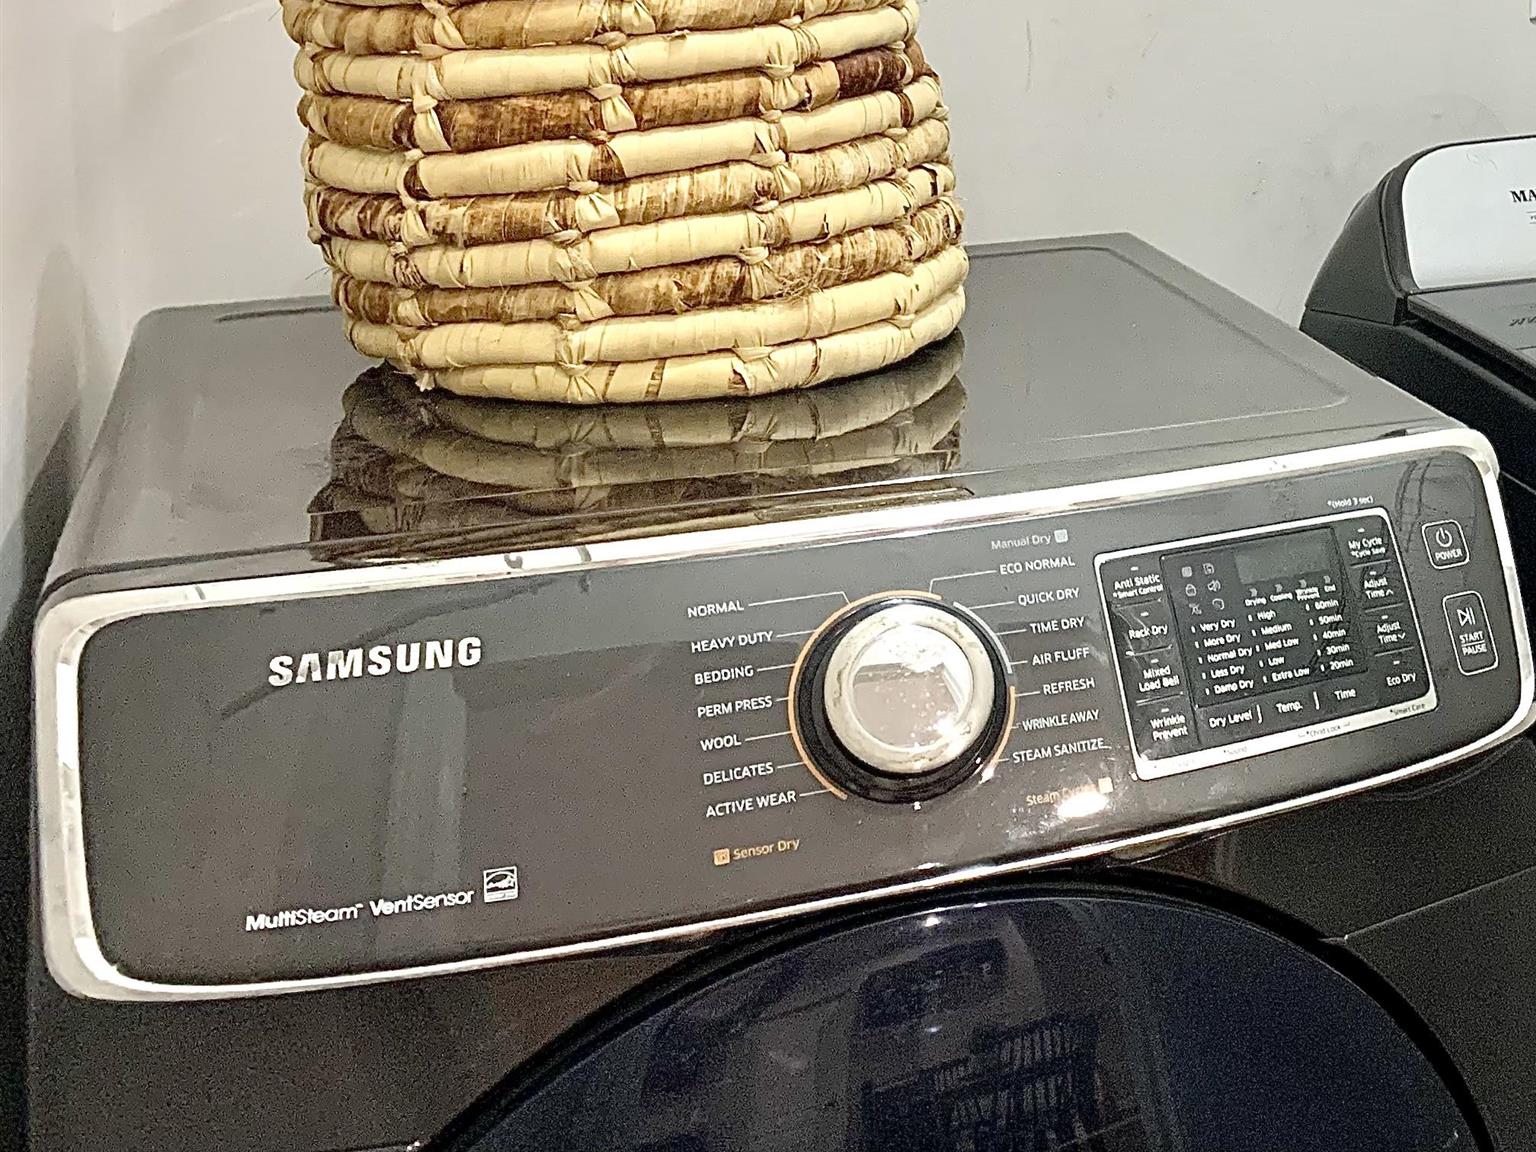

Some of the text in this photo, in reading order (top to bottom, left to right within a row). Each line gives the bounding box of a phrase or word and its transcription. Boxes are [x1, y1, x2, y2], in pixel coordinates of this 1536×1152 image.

[991, 532, 1052, 550] Manual Dry
[1348, 536, 1383, 550] My Cycle
[1434, 548, 1463, 561] POWER
[999, 556, 1076, 576] ECO NORMAL
[1114, 574, 1161, 590] Anti Static
[1364, 576, 1388, 589] Adjust
[1017, 587, 1080, 608] QUICK DRY
[1365, 589, 1385, 600] Time
[687, 599, 745, 618] NORMAL
[1315, 599, 1339, 610] 60min
[1257, 609, 1276, 621] High
[1318, 614, 1343, 625] 50min
[1030, 617, 1085, 634] TIME DRY
[1128, 624, 1168, 640] Rack Dry
[1200, 619, 1236, 632] Very Dry
[1261, 623, 1293, 635] Medium
[1377, 621, 1401, 634] Adjust
[1203, 633, 1241, 648] More Dry
[1322, 629, 1347, 639] 40min
[1378, 633, 1398, 644] Time
[1459, 630, 1484, 644] START
[691, 630, 774, 654] HEAVY DUTY
[1264, 638, 1299, 651] Med Low
[1326, 644, 1350, 655] 30min
[1032, 647, 1090, 665] AIR FLUFF
[1207, 647, 1253, 663] Normal Dry
[1461, 644, 1487, 656] PAUSE
[268, 636, 482, 687] SAMSUNG
[1268, 656, 1285, 666] Low
[1329, 659, 1354, 670] 20min
[694, 665, 754, 685] BEDDING
[1143, 665, 1171, 679] Mixed
[1210, 664, 1245, 679] Less Dry
[1272, 668, 1310, 682] Extra Low
[1042, 677, 1096, 695] REFRESH
[1138, 680, 1161, 693] Load
[1213, 679, 1254, 695] Damp Dry
[1386, 673, 1416, 687] Eco Dry
[1334, 688, 1356, 700] Time
[697, 695, 773, 718] PERM PRESS
[1276, 701, 1303, 713] Temp.
[1022, 709, 1099, 732] WRINKLE AWAY
[1150, 714, 1186, 729] Wrinkle
[1208, 710, 1253, 729] Dry Level
[1152, 726, 1189, 742] Prevent
[700, 733, 742, 752] WOOL
[1012, 738, 1105, 764] STEAM SANITIZE
[703, 762, 774, 786] DELICATES
[705, 790, 797, 818] ACTIVE WEAR
[1026, 791, 1060, 806] Steam
[733, 839, 800, 860] Sensor Dry
[369, 889, 474, 917] VentSensor
